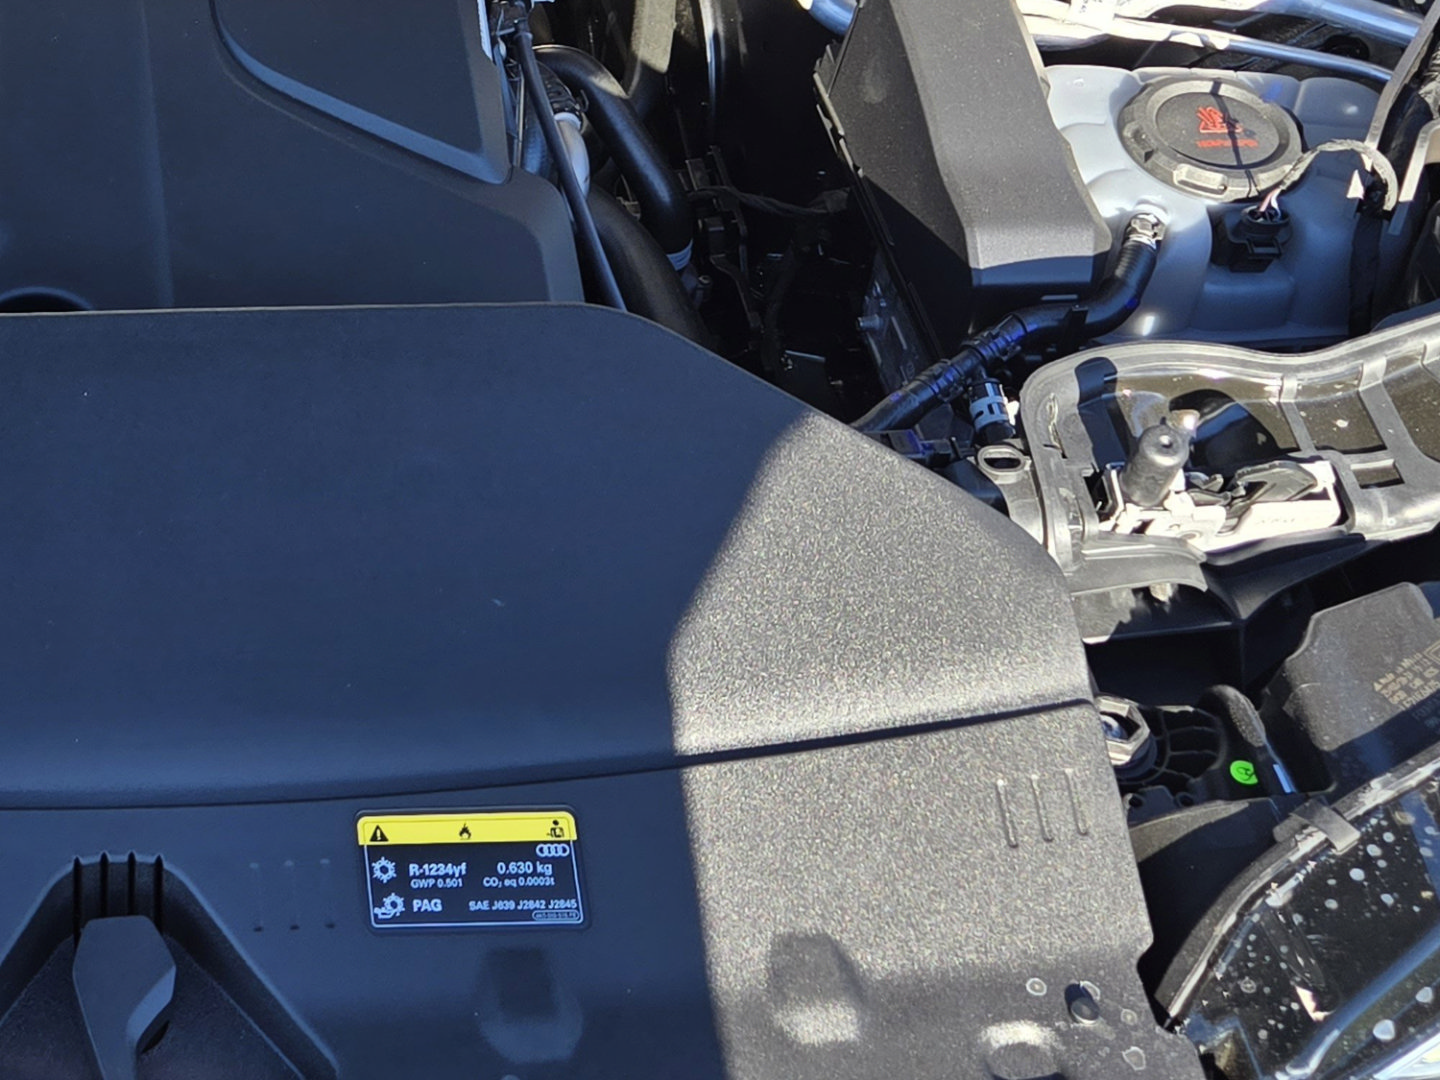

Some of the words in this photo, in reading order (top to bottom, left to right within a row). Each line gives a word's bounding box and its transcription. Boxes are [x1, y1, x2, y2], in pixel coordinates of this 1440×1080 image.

[409, 862, 467, 877] R-1234yf
[497, 862, 533, 874] 0.630
[536, 862, 552, 875] kg
[410, 879, 435, 888] GWP
[413, 899, 442, 912] PAG
[469, 901, 489, 911] SAE
